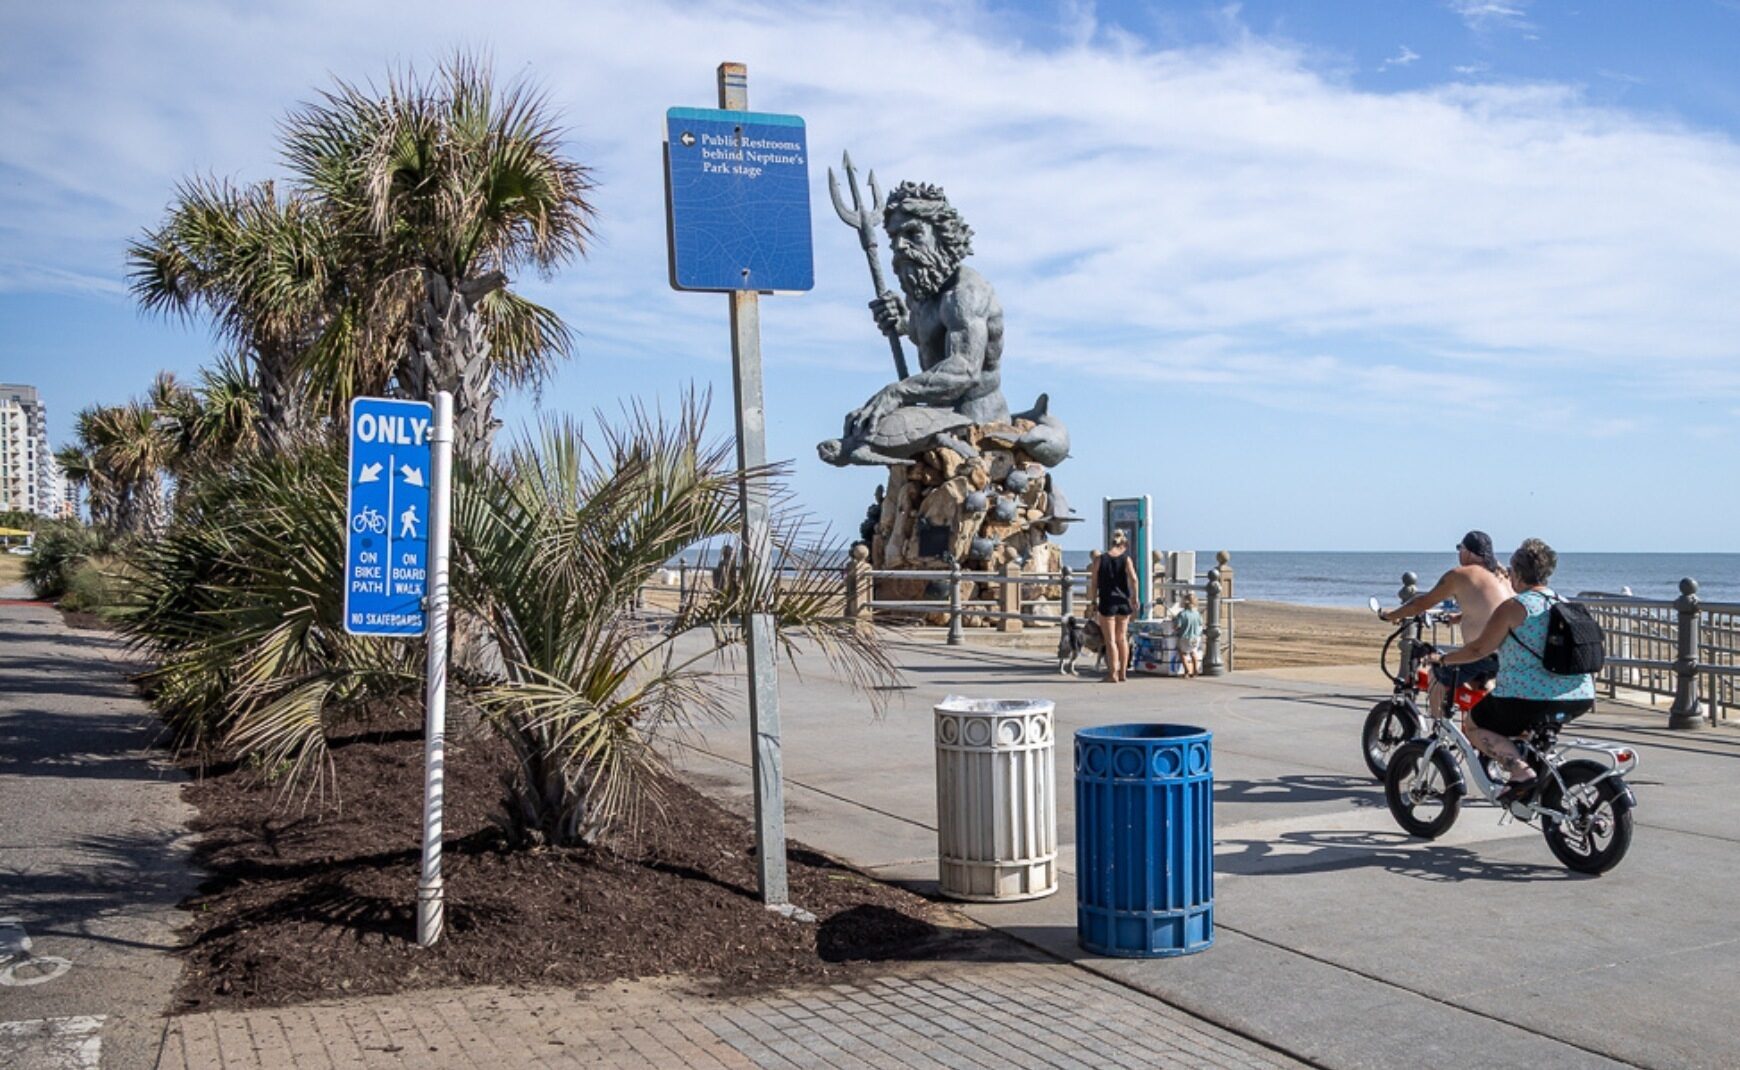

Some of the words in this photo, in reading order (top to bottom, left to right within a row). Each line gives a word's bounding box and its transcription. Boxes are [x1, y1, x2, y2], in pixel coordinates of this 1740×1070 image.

[702, 134, 739, 147] Public
[741, 137, 801, 150] Restrooms
[702, 148, 743, 161] behind
[746, 152, 804, 165] Neptune's
[703, 162, 730, 174] Park
[732, 165, 762, 178] stage
[357, 413, 428, 446] ONLY
[360, 552, 378, 564] ON
[402, 553, 417, 565] ON
[355, 566, 381, 579] BIKE
[393, 567, 426, 581] BOARD
[352, 581, 383, 593] PATH
[395, 582, 422, 595] WALK
[351, 612, 363, 624] NO
[366, 613, 423, 626] SKATEBOARDS
